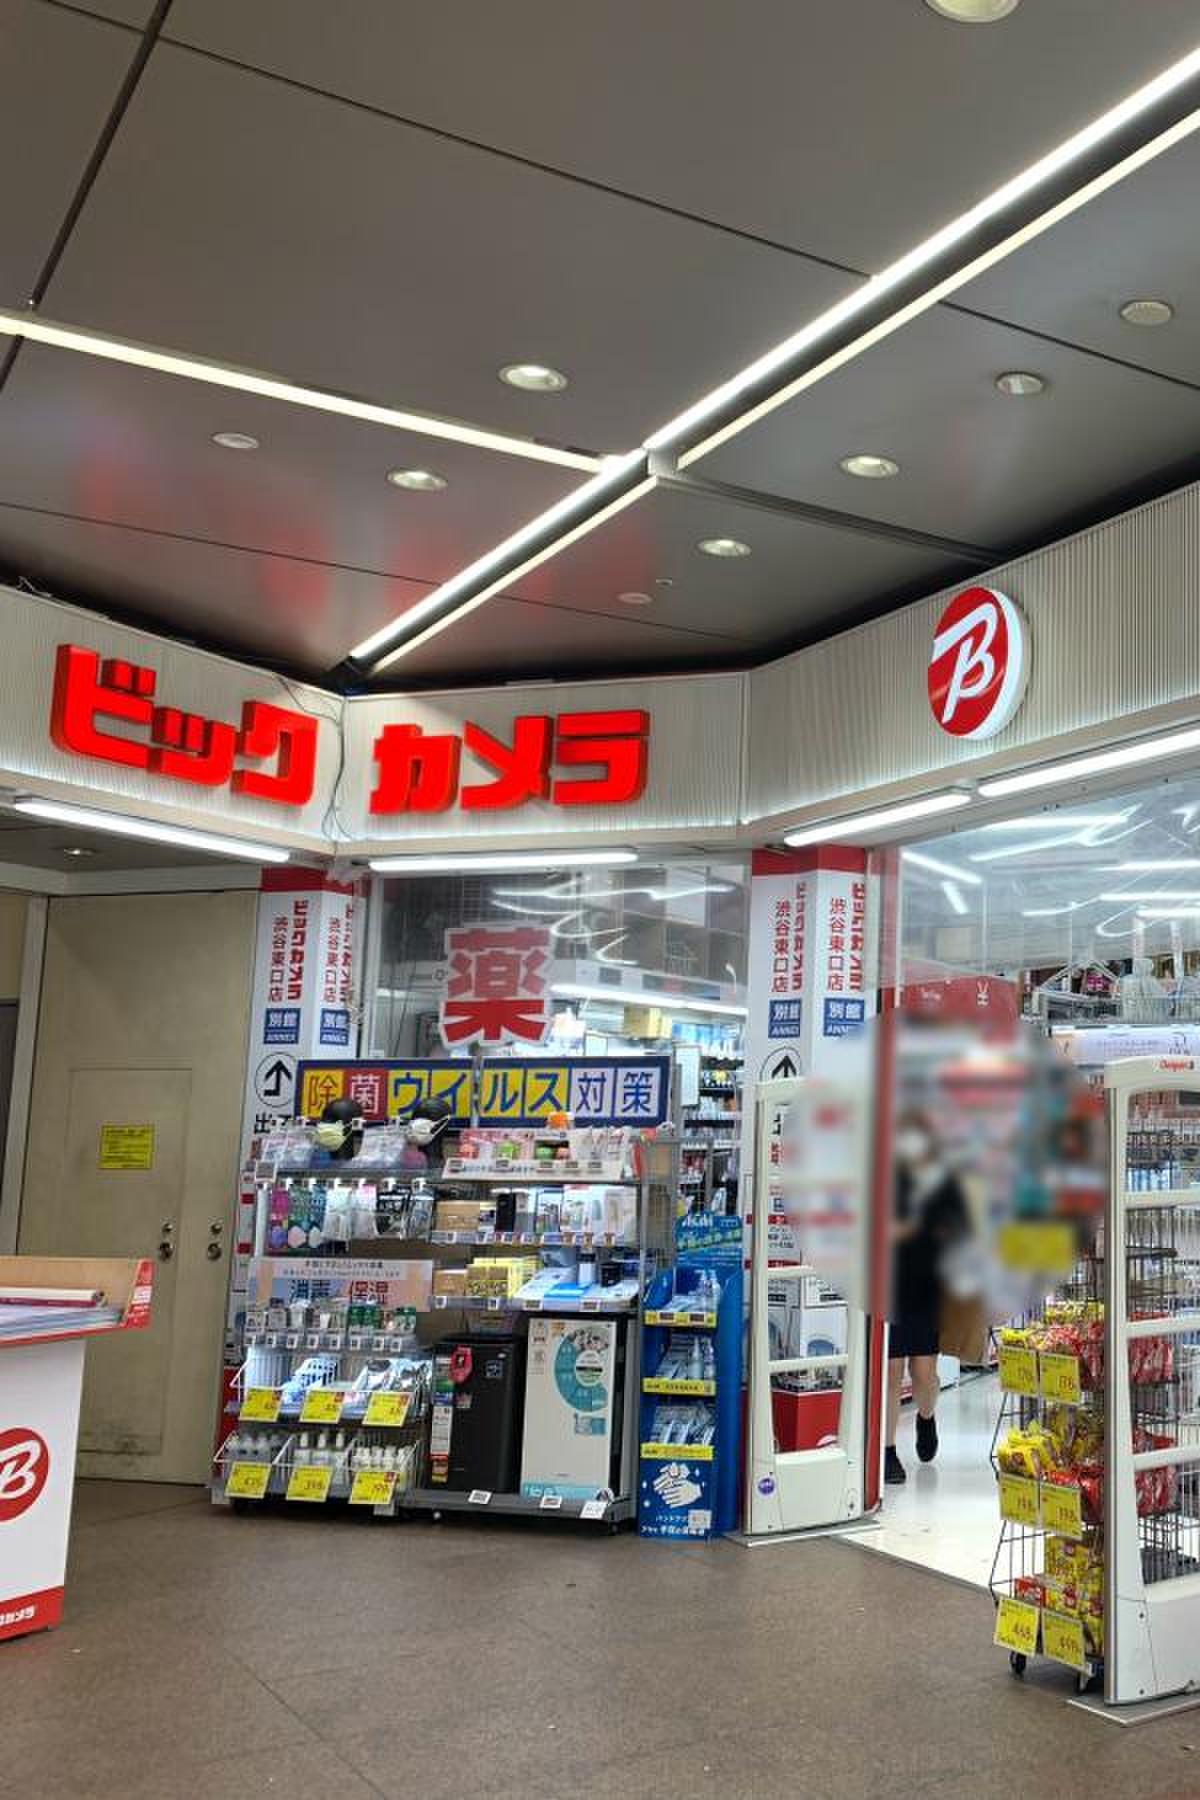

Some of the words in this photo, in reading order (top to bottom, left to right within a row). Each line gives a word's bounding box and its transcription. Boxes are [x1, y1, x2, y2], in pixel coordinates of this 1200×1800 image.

[50, 643, 319, 807] ビック
[369, 708, 650, 815] カメラ
[443, 927, 551, 1044] 薬
[307, 1069, 654, 1119] 除菌ウイルス対策
